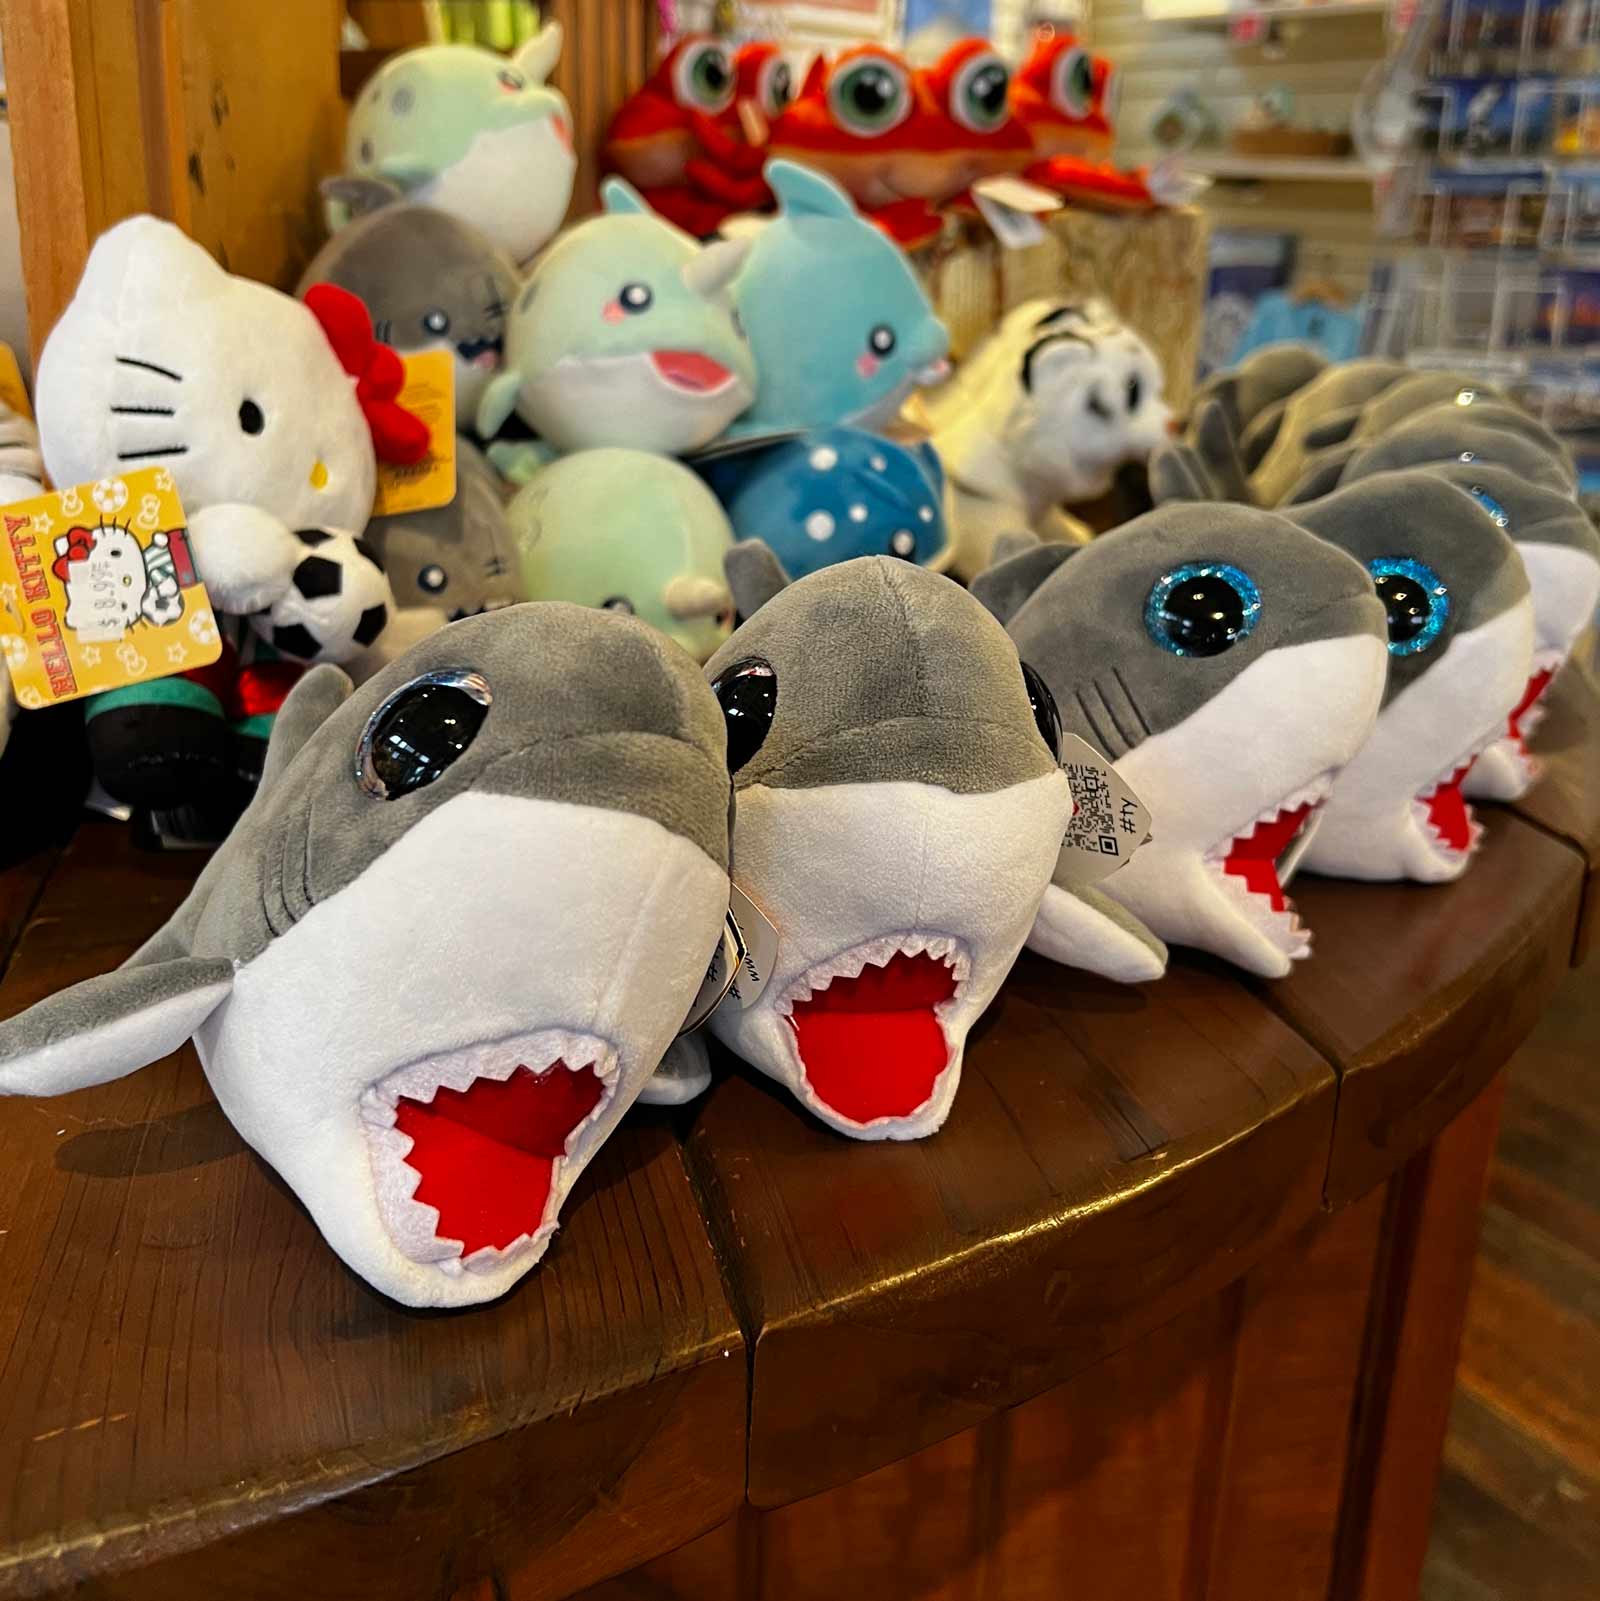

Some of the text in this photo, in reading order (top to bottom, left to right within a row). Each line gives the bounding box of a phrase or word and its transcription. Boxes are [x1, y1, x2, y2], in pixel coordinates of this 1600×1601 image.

[4, 514, 78, 699] HELLO KITTY
[1119, 797, 1139, 835] #ty
